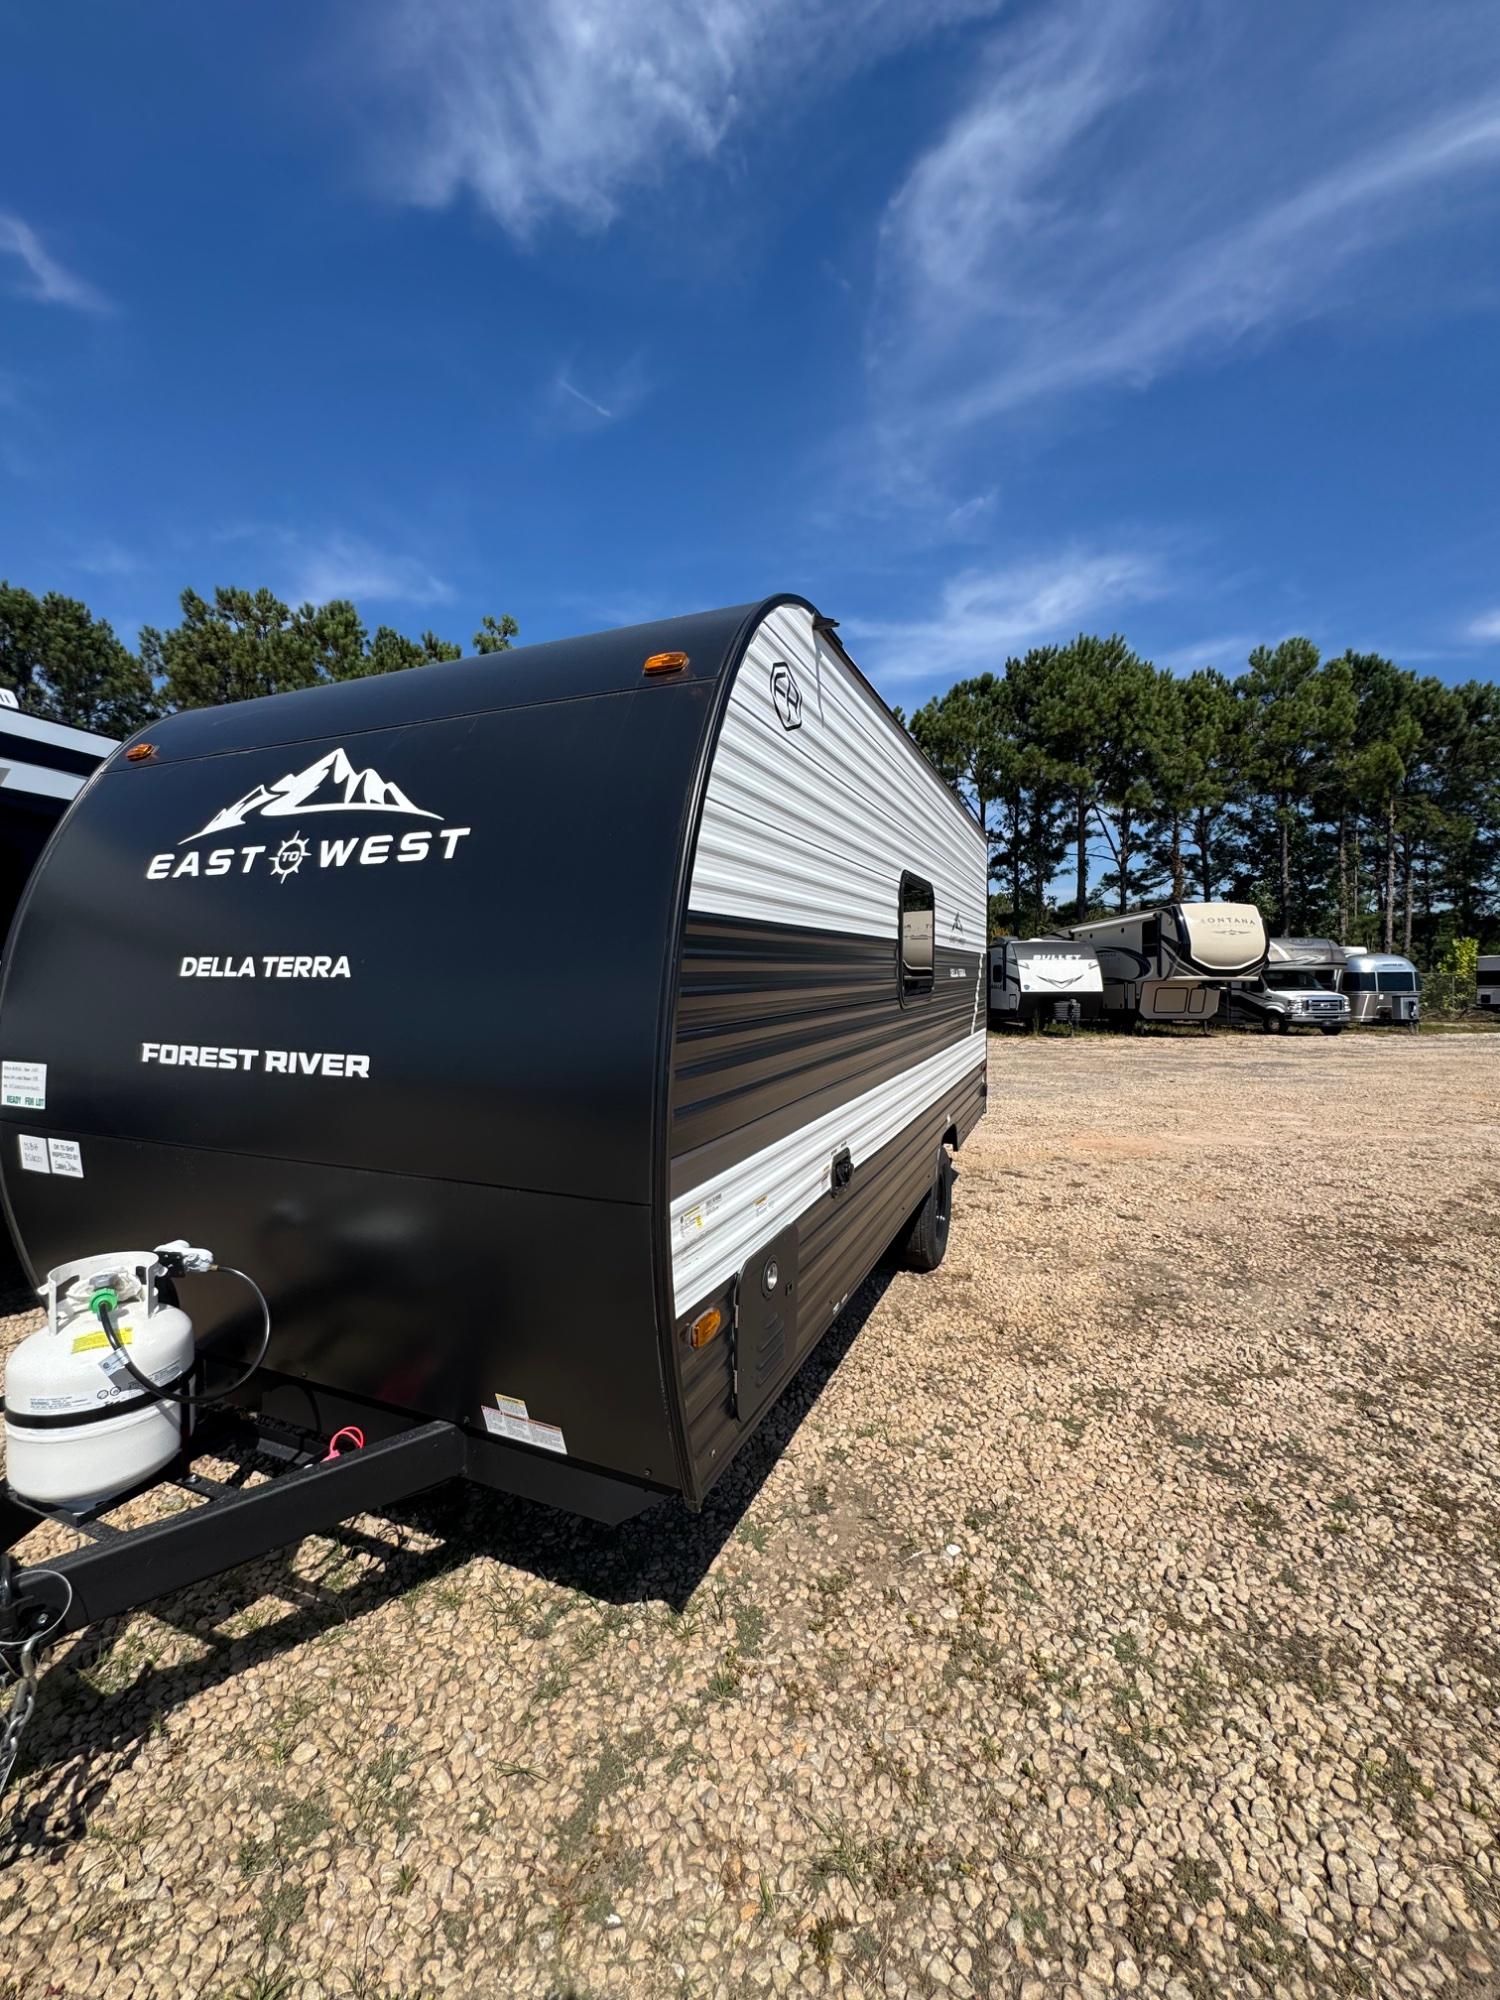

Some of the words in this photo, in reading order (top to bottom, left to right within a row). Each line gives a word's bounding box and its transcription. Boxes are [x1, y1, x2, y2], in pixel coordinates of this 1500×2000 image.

[146, 845, 266, 879] EAST
[282, 850, 300, 862] TO
[319, 827, 471, 867] WEST
[179, 956, 256, 978] DELLA
[262, 955, 352, 978] TERRA
[142, 1042, 260, 1071] FOREST
[264, 1050, 371, 1079] RIVER
